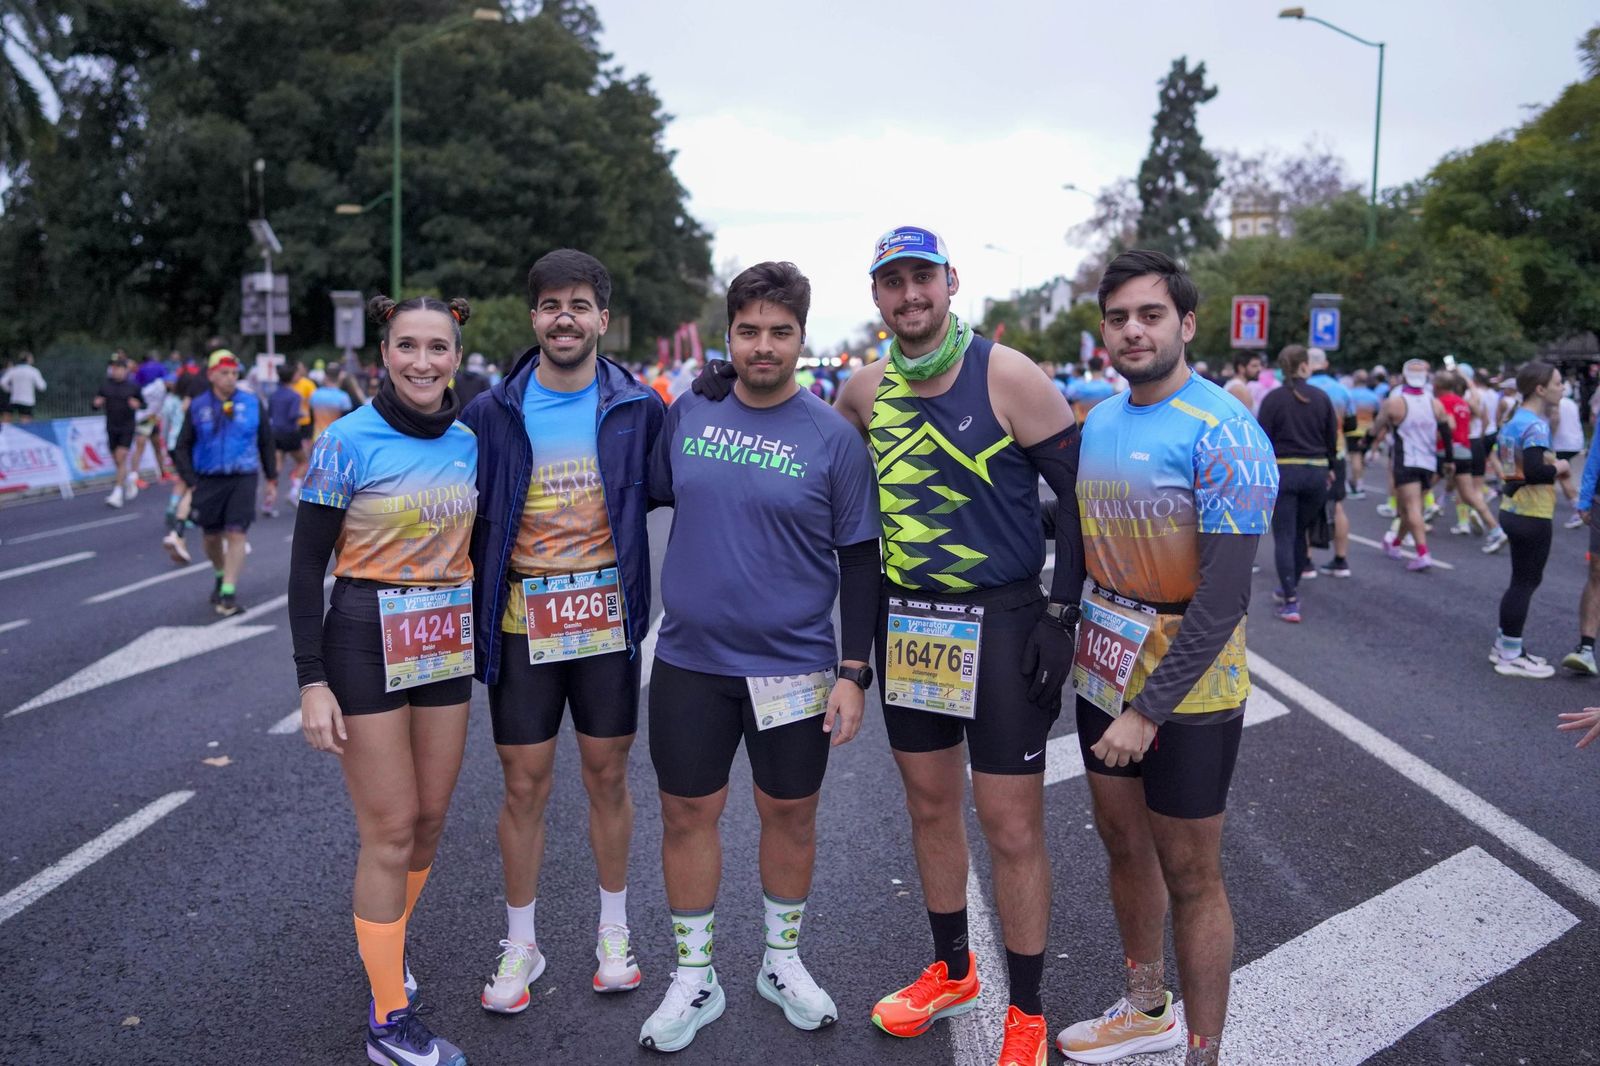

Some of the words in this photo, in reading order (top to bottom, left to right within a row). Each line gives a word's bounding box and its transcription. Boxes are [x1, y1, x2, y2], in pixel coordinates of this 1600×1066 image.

[1316, 312, 1333, 332] P
[682, 436, 808, 479] ARMOUR
[702, 425, 798, 460] UNDER
[403, 483, 468, 509] MEDIO
[543, 471, 601, 496] MAR
[546, 592, 603, 623] 1426
[400, 612, 455, 646] 1424
[894, 638, 962, 673] 16476
[1087, 628, 1122, 671] 1428
